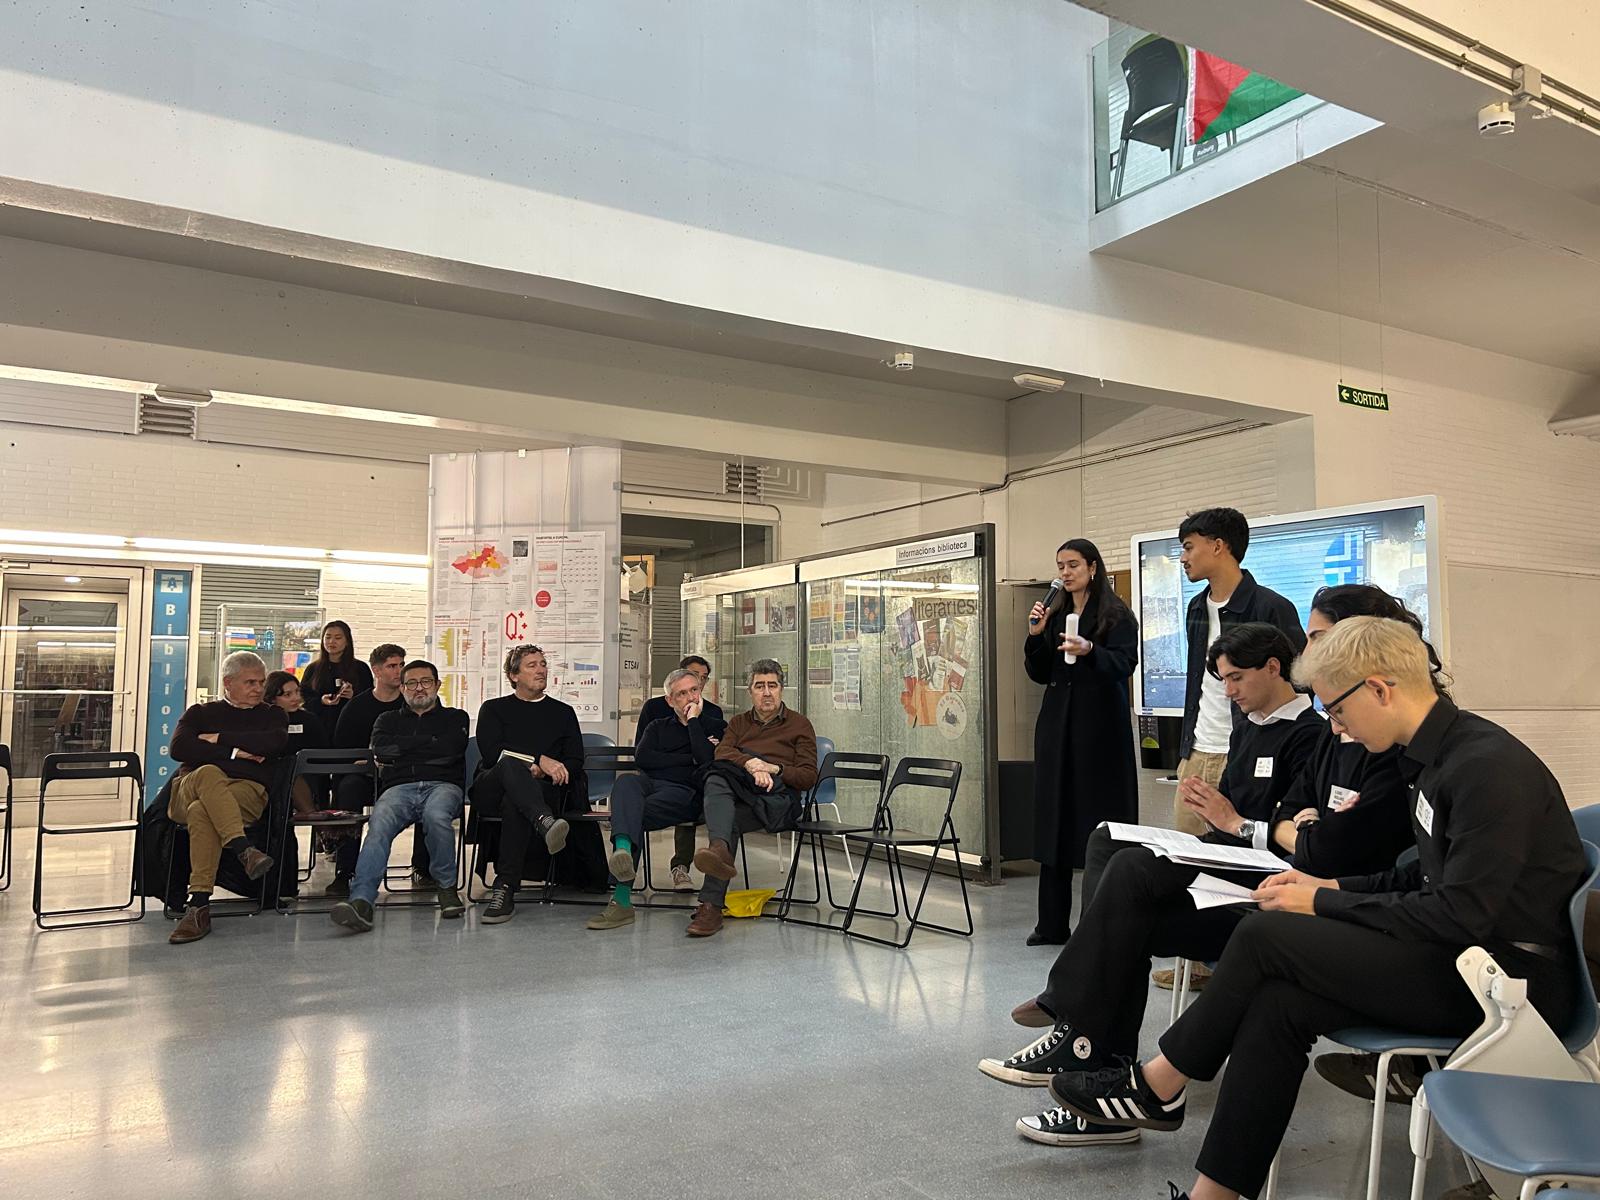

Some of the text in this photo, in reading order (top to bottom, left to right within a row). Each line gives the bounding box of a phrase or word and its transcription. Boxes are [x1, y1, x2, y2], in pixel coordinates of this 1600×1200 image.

[1352, 391, 1386, 408] SORTIDA
[899, 541, 967, 558] Informacions biblioteca
[913, 598, 975, 620] literàries
